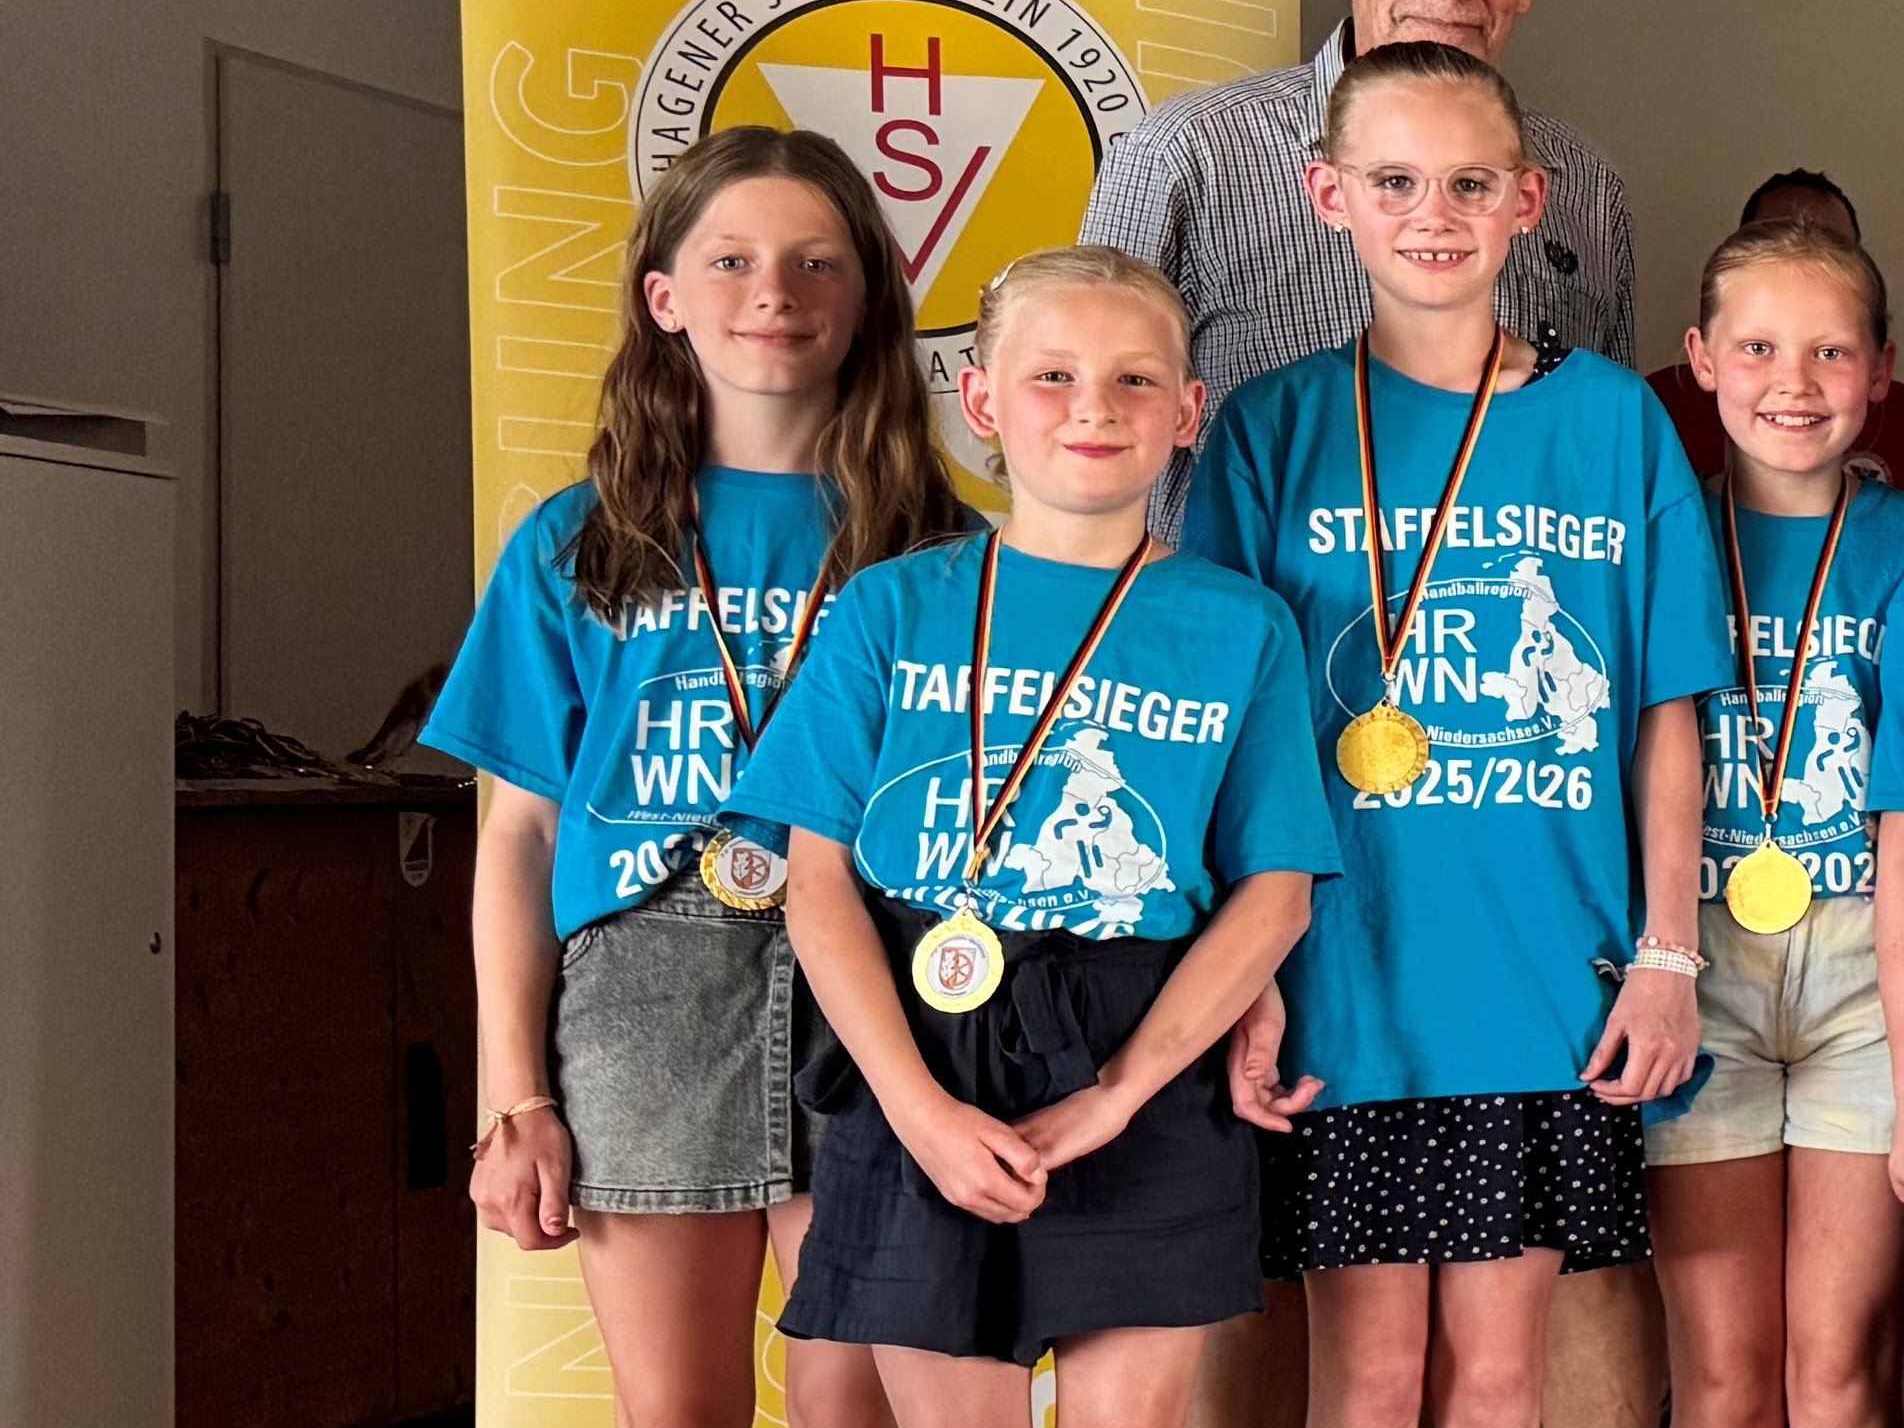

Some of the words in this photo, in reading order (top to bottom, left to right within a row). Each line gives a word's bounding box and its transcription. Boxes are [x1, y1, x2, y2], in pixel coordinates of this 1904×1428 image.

[650, 0, 757, 174] HAGENER
[1056, 27, 1130, 112] 1920
[635, 699, 737, 751] HR
[630, 753, 733, 807] WN
